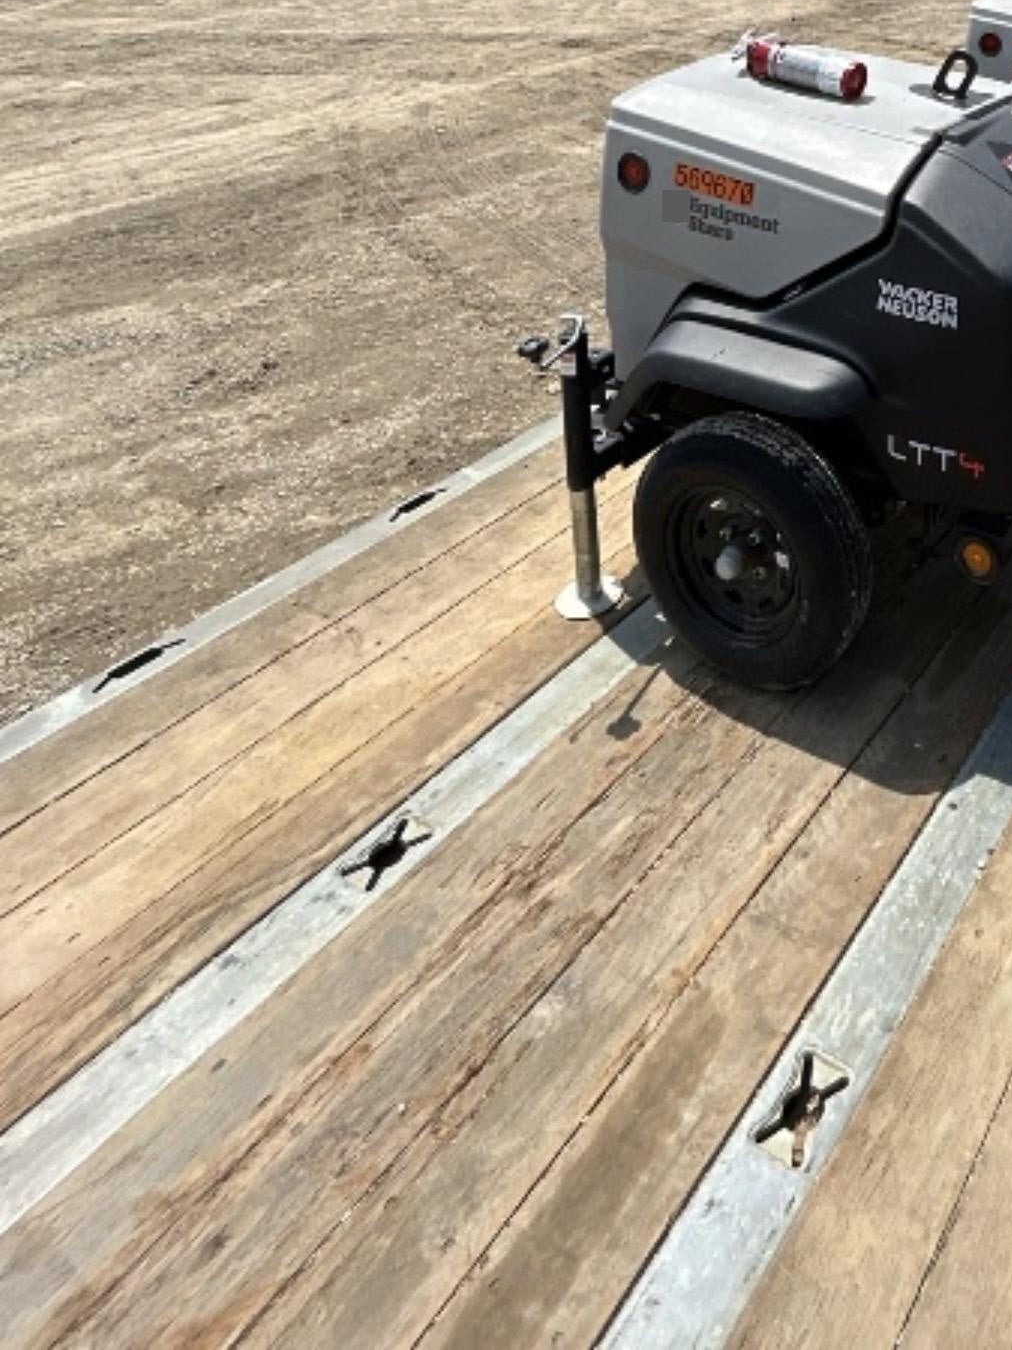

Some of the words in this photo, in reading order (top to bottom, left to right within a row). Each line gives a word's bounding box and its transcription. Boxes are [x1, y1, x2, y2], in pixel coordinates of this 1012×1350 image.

[689, 196, 781, 235] Equipment
[875, 295, 958, 330] NEUSON
[877, 278, 958, 313] WACKER
[886, 434, 985, 479] LTT4
